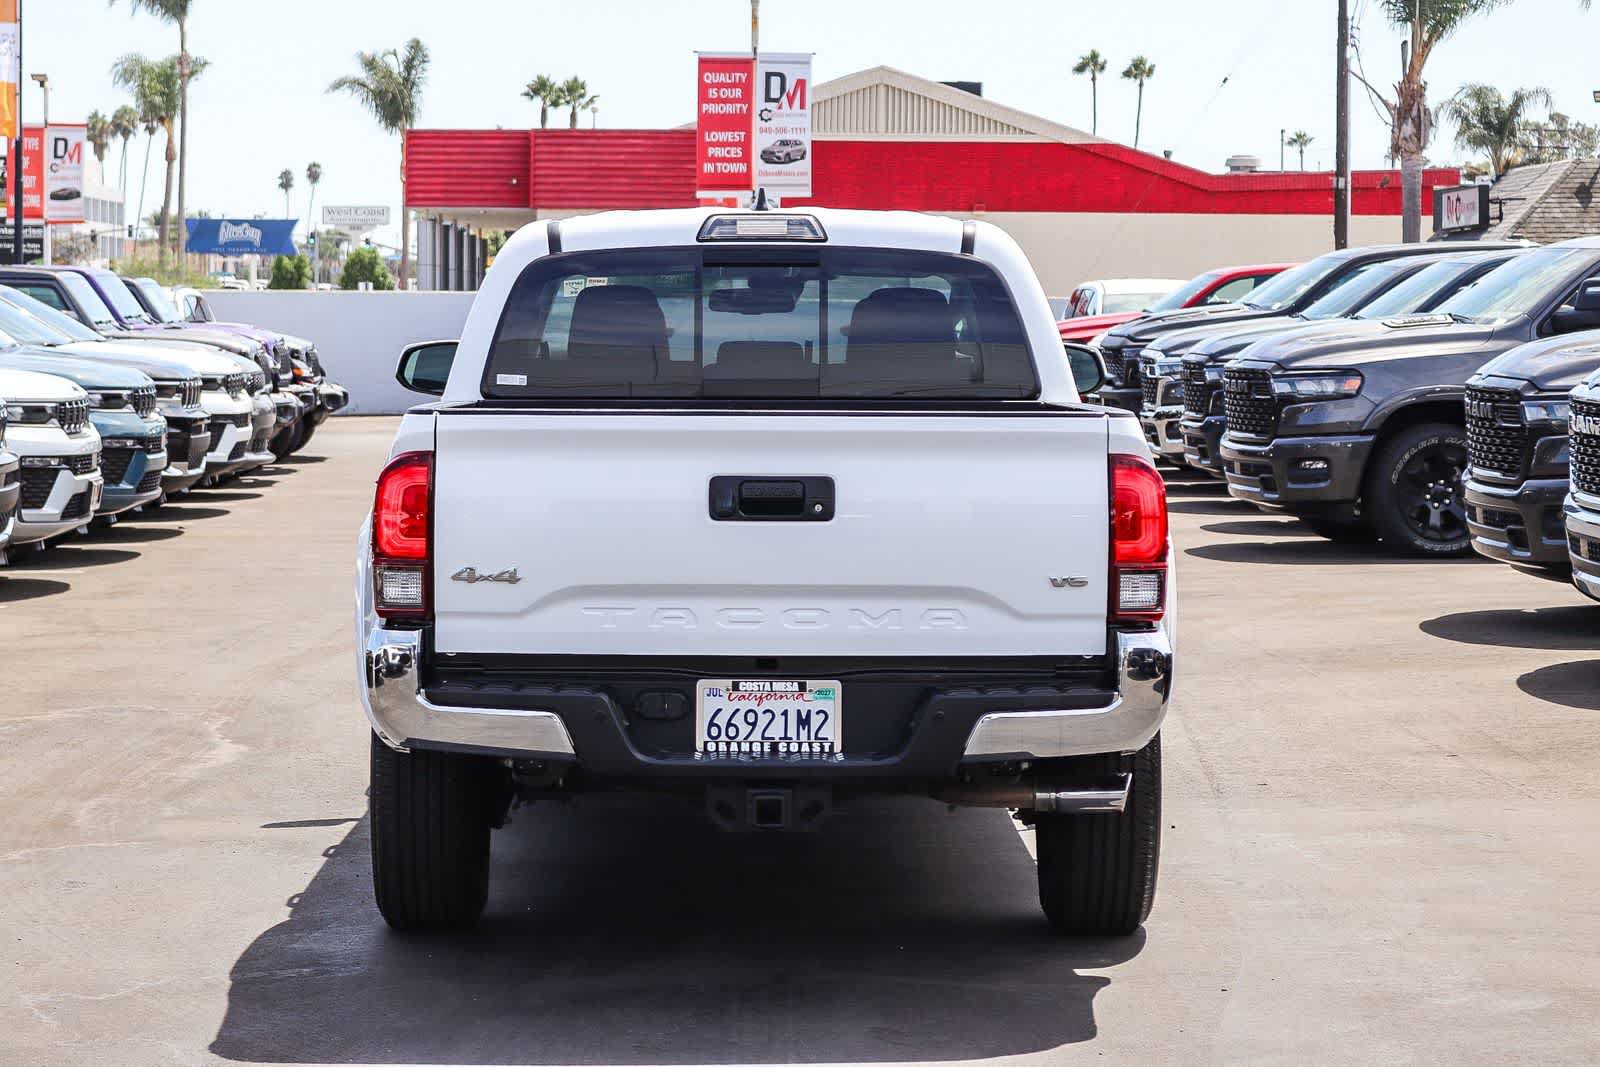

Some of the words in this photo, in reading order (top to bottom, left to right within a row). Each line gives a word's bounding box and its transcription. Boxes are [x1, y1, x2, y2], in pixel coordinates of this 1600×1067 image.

[703, 72, 748, 84] QUALITY
[709, 88, 718, 98] IS
[720, 88, 742, 99] OUR
[702, 104, 748, 114] PRIORITY
[705, 132, 746, 142] LOWEST
[708, 147, 743, 158] PRICES
[703, 162, 715, 173] IN
[716, 162, 747, 173] TOWN
[451, 567, 522, 584] 4x4
[1049, 576, 1089, 588] V6
[582, 607, 967, 630] TACOMA
[739, 681, 771, 692] COSTA
[773, 681, 799, 692] MESA
[706, 688, 723, 698] JUL
[706, 707, 829, 741] 66921M2
[707, 742, 771, 752] ORANGE
[778, 742, 832, 752] COAST
